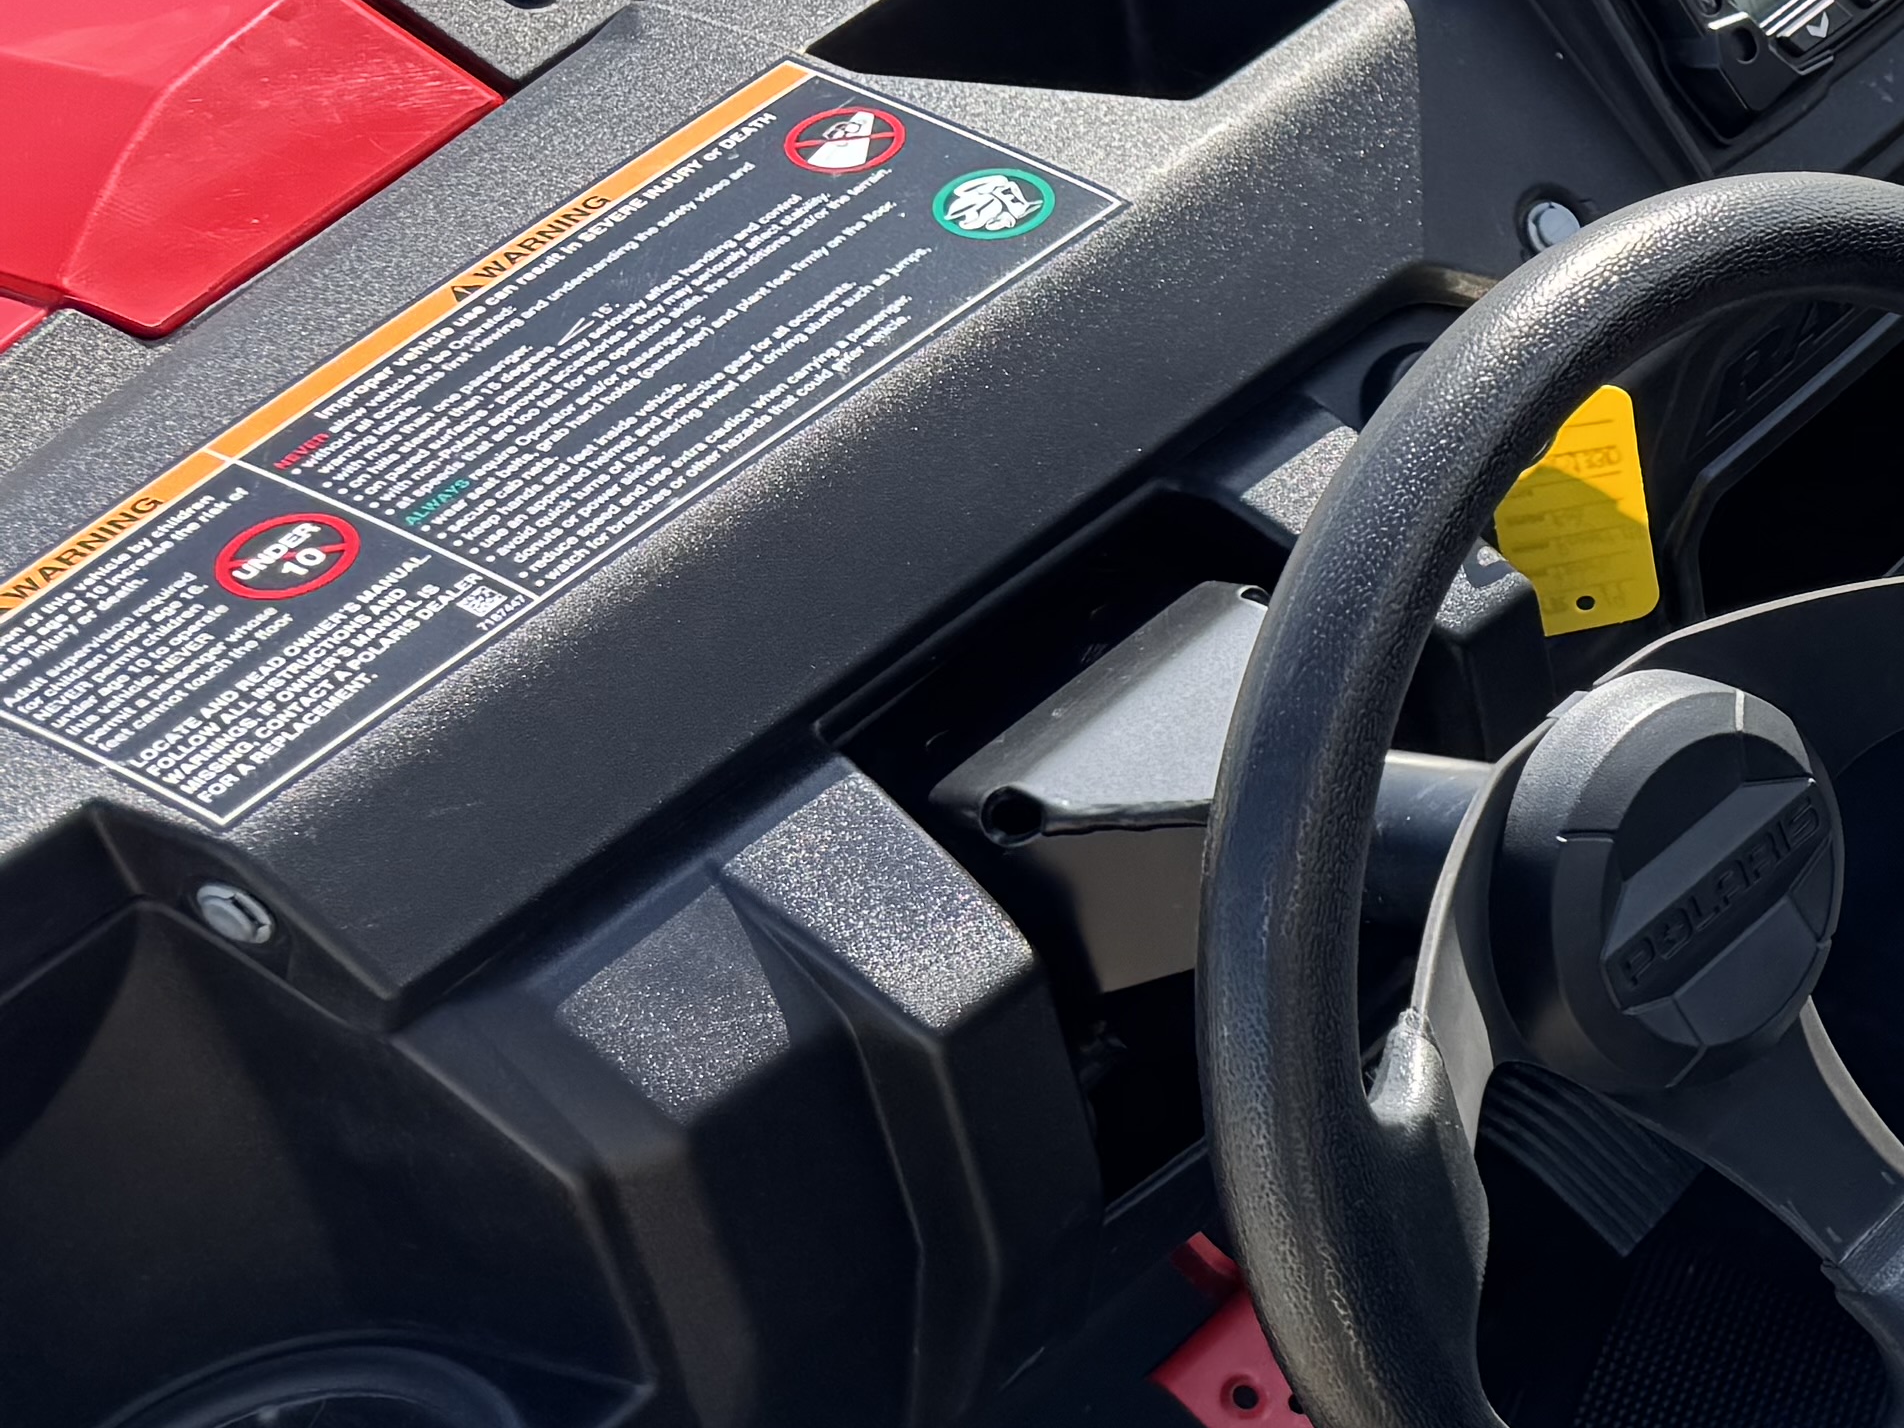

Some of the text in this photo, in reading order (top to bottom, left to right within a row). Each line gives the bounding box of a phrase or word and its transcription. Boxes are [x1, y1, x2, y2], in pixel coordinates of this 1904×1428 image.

[312, 112, 777, 419] Improper vehicle use can result in SEVERE INJURY or DEATH
[472, 195, 611, 278] WARNING
[273, 432, 329, 469] NEVER
[327, 406, 367, 433] allow
[364, 373, 416, 407] vehicle
[411, 362, 432, 374] to
[426, 349, 452, 363] be
[316, 404, 422, 473] warning labels.
[331, 344, 533, 481] with more than one passenger.
[348, 472, 371, 488] on
[365, 452, 401, 474] hills
[397, 415, 451, 453] steeper
[447, 394, 484, 417] than
[479, 380, 502, 394] 15
[499, 345, 556, 383] degrees
[404, 314, 706, 526] ALWAYS require Operator and/or Passenger to:
[459, 382, 687, 541] keep hands and feet inside vehicle.
[478, 281, 857, 548] use an approved helmet and protective gear for all occupants.
[527, 294, 912, 572] reduce speed and use extra caution when carrying a passenger.
[1, 496, 163, 599] WARNING
[23, 494, 215, 627] of this vehicle by children
[231, 522, 321, 580] UNDER
[280, 547, 326, 575] 10
[446, 455, 559, 533] secure cab nets.
[512, 454, 666, 563] donuts or power slides.
[6, 634, 38, 655] the
[35, 613, 69, 636] age
[67, 598, 88, 614] of
[84, 584, 109, 599] 10
[103, 539, 174, 586] increase
[169, 521, 201, 541] the
[197, 500, 232, 523] risk
[227, 486, 249, 501] of
[26, 623, 79, 658] injury
[76, 609, 98, 625] or
[95, 577, 149, 611] death.
[475, 593, 525, 631] 7187447
[2, 675, 48, 708] Adult
[44, 616, 135, 677] supervision
[131, 571, 197, 617] required
[16, 695, 44, 714] for
[42, 652, 108, 697] children
[104, 620, 151, 654] under
[150, 600, 183, 622] age
[31, 603, 205, 721] NEVER permit children
[49, 603, 229, 728] under age 10 to operate
[64, 632, 215, 736] this vehicle. NEVER
[82, 606, 278, 745] permit a passenger whose
[97, 612, 293, 752] feet cannot touch the floor
[126, 553, 432, 768] LOCATE AND READ OWNER'S MANUAL.
[145, 587, 407, 777] FOLLOW ALL INSTRUCTIONS AND
[161, 583, 440, 784] WARNINGS. IF OWNER'S MANUAL IS
[179, 572, 483, 794] MISSING, CONTACT A POLARIS DEALER
[196, 671, 378, 803] FOR A REPLACEMENT.
[1618, 795, 1822, 988] POLARIS
